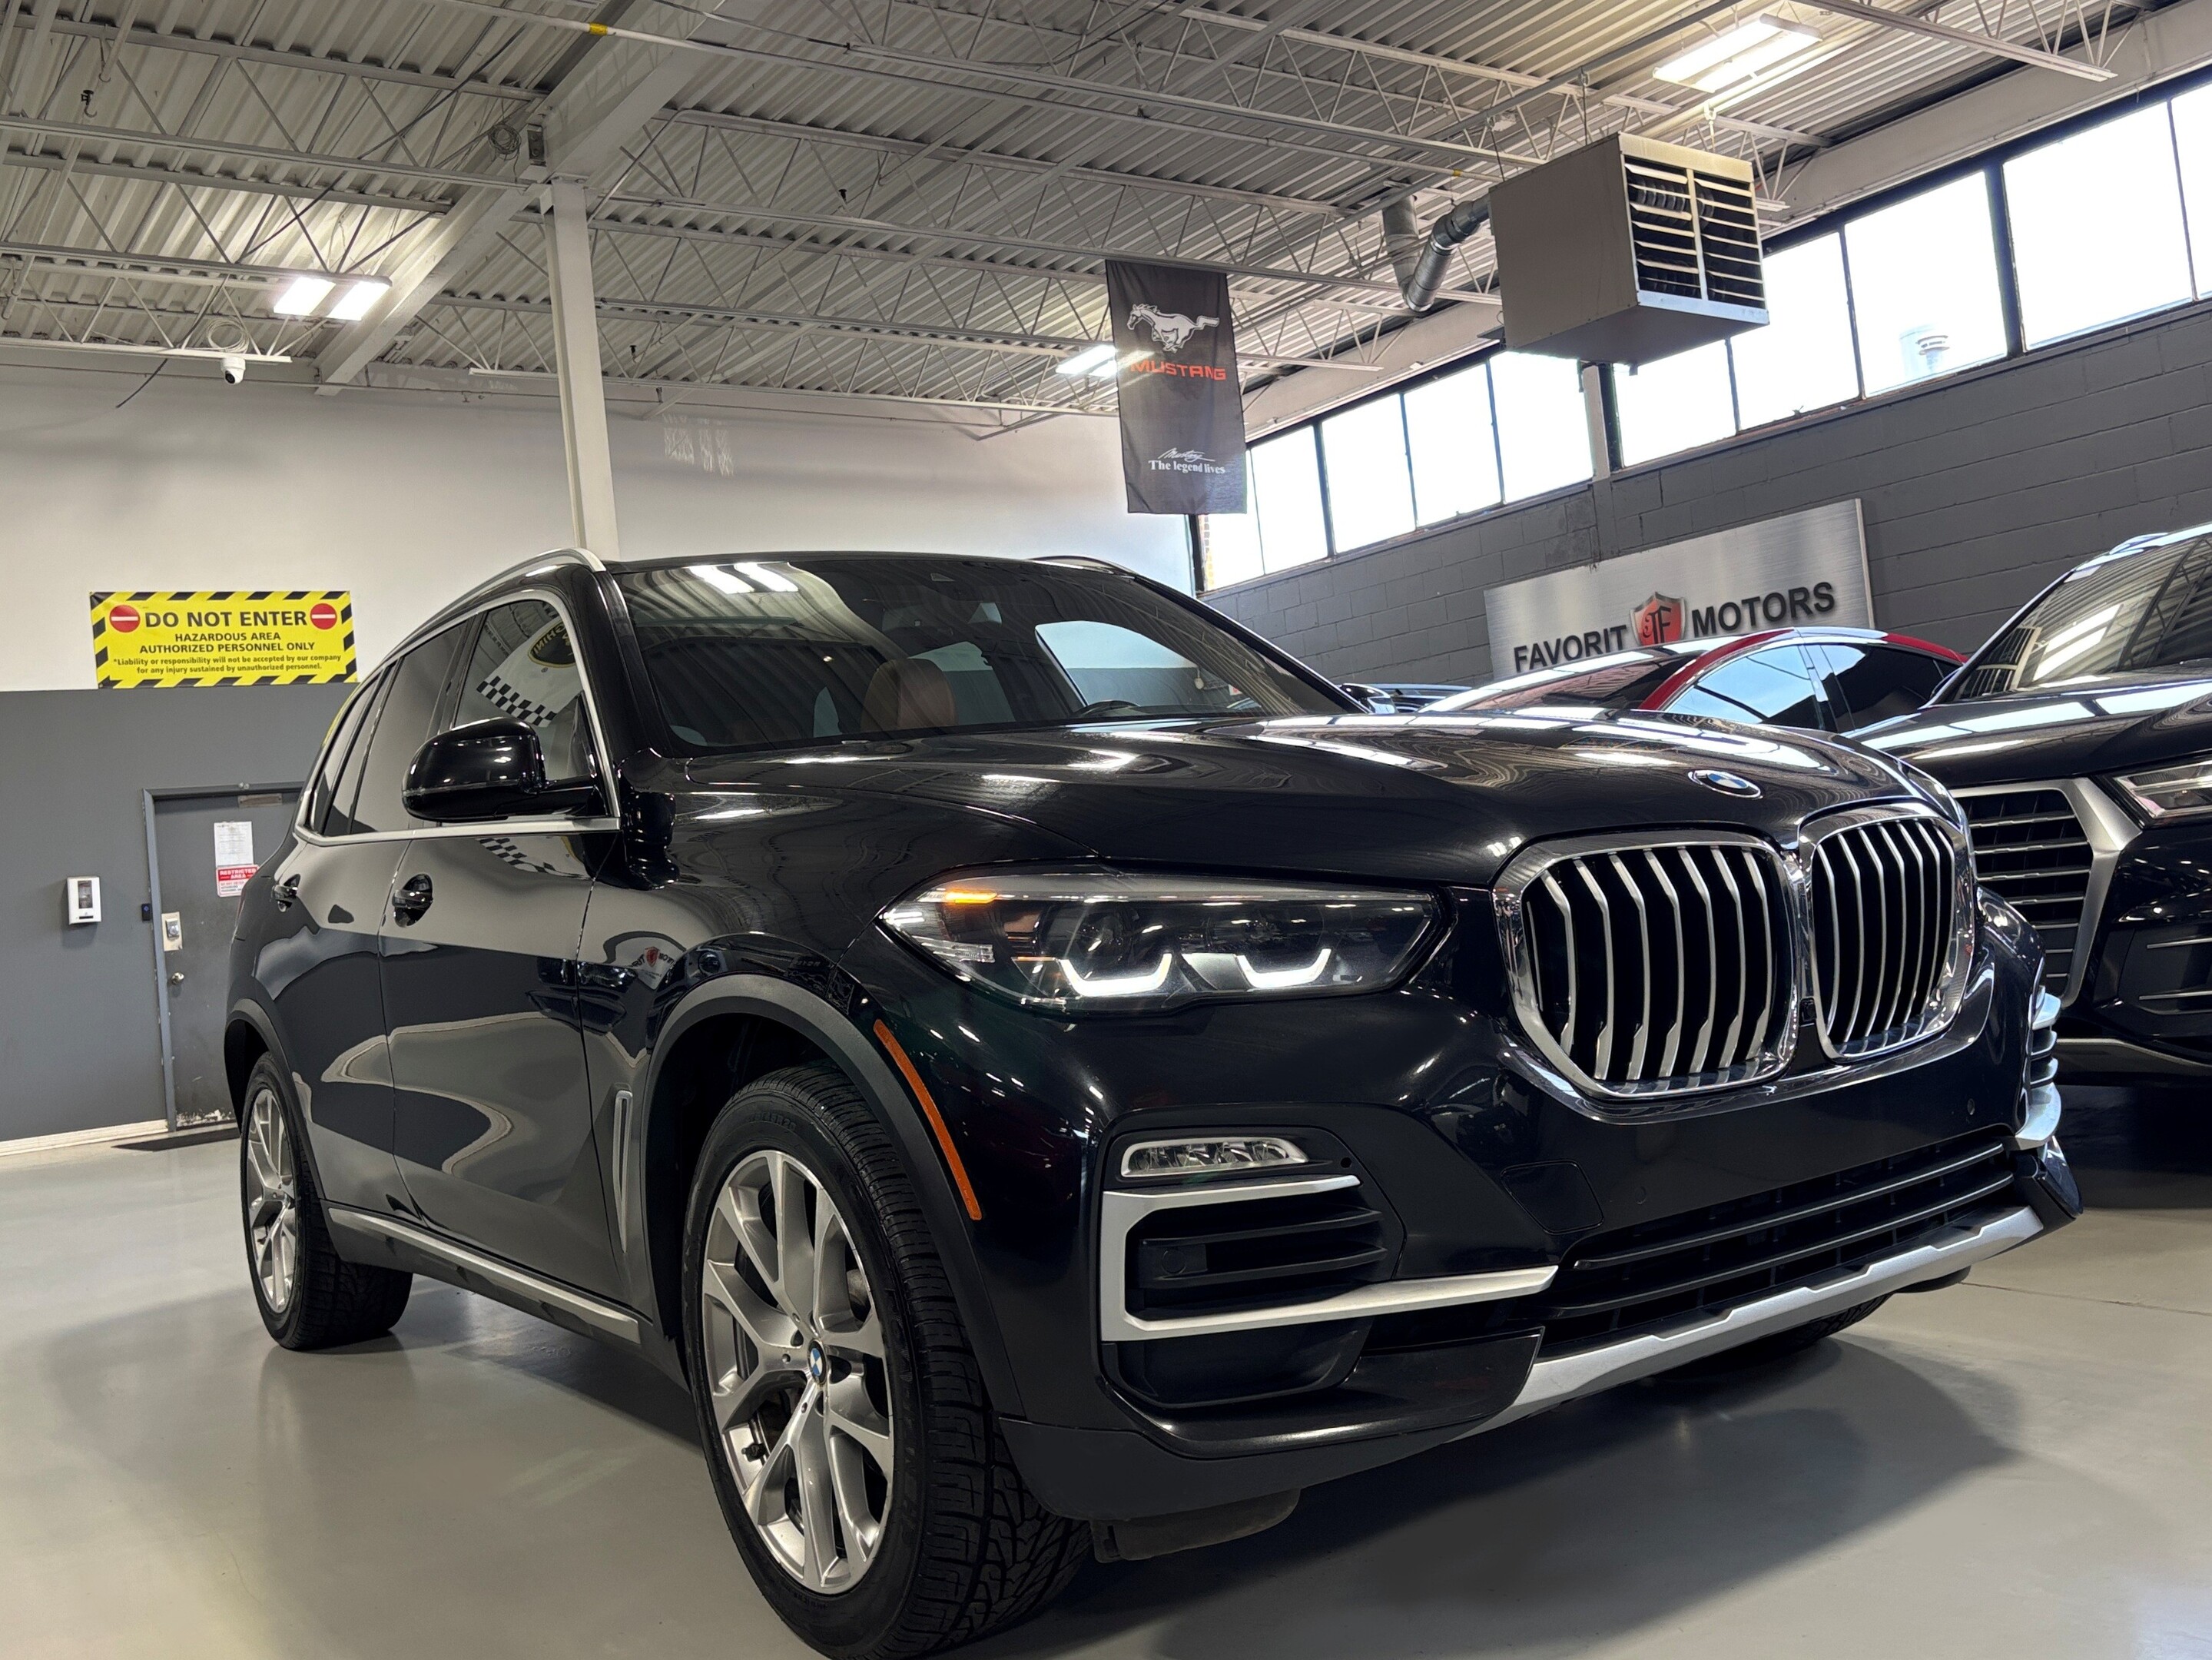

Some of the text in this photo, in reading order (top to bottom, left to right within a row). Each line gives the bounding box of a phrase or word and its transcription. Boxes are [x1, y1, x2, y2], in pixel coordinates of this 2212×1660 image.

[1130, 358, 1227, 381] MUSTANG
[1148, 460, 1226, 474] The legend lives
[144, 610, 307, 628] DO NOT ENTER
[1514, 624, 1627, 673] FAVORIT
[1691, 581, 1835, 639] MOTORS
[174, 632, 281, 642] HAZARDOUS AREA
[139, 642, 315, 654] AUTHORIZED PERSONNEL ONLY
[161, 657, 211, 666] responsibility
[253, 655, 284, 663] accepted
[166, 666, 187, 675] injury
[286, 662, 322, 671] personnel.
